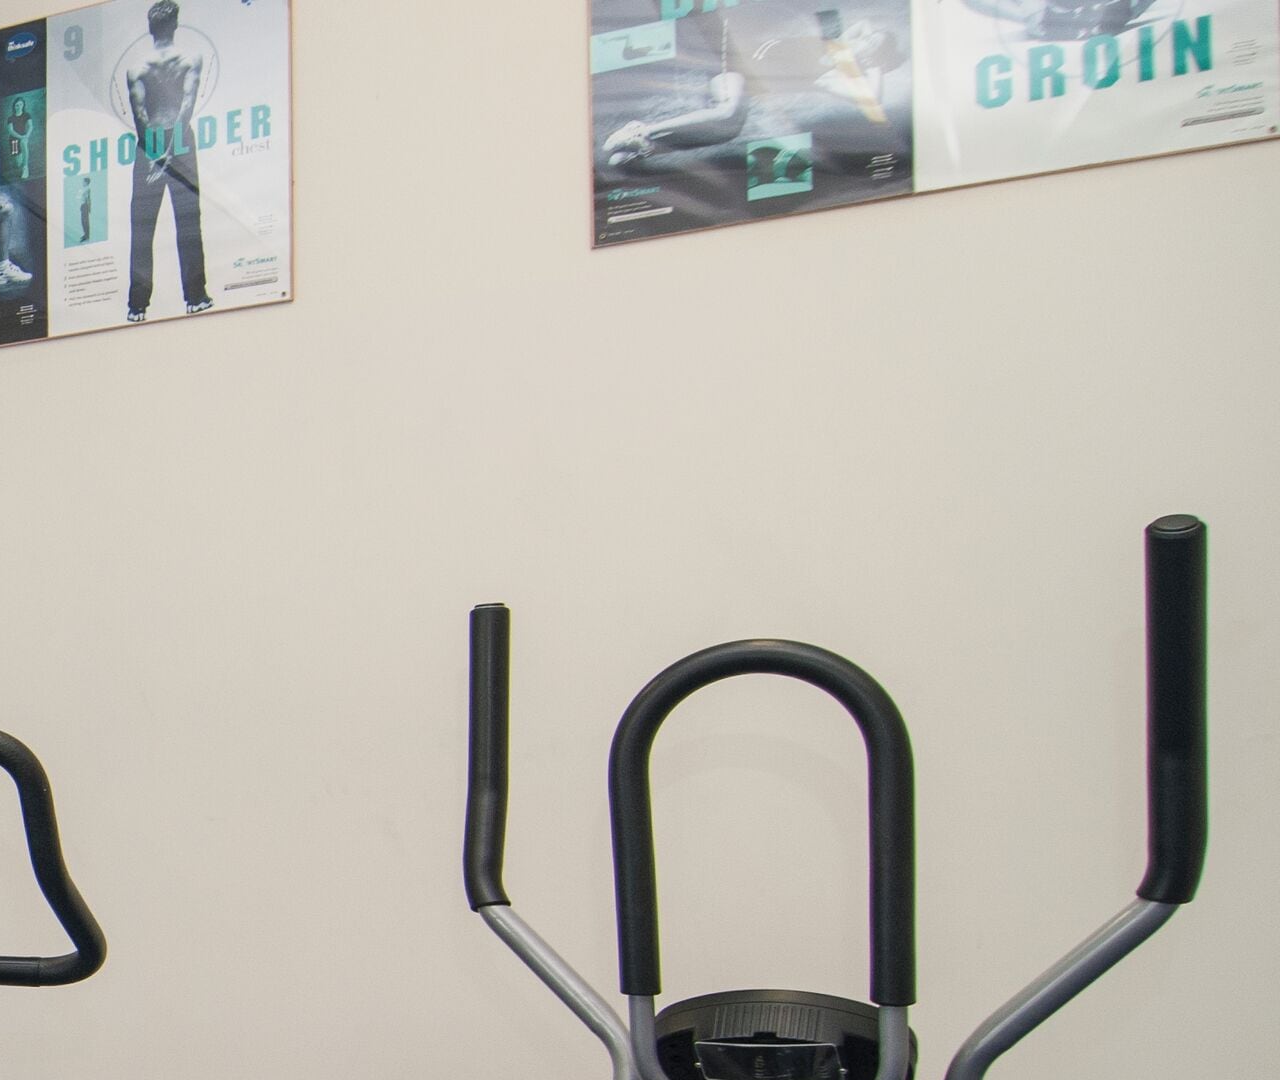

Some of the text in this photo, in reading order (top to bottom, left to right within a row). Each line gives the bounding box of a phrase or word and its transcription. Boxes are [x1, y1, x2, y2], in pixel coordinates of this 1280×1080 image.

[63, 25, 84, 61] 9
[975, 14, 1213, 109] GROIN
[63, 104, 272, 177] SHOULDER
[231, 139, 272, 158] chest
